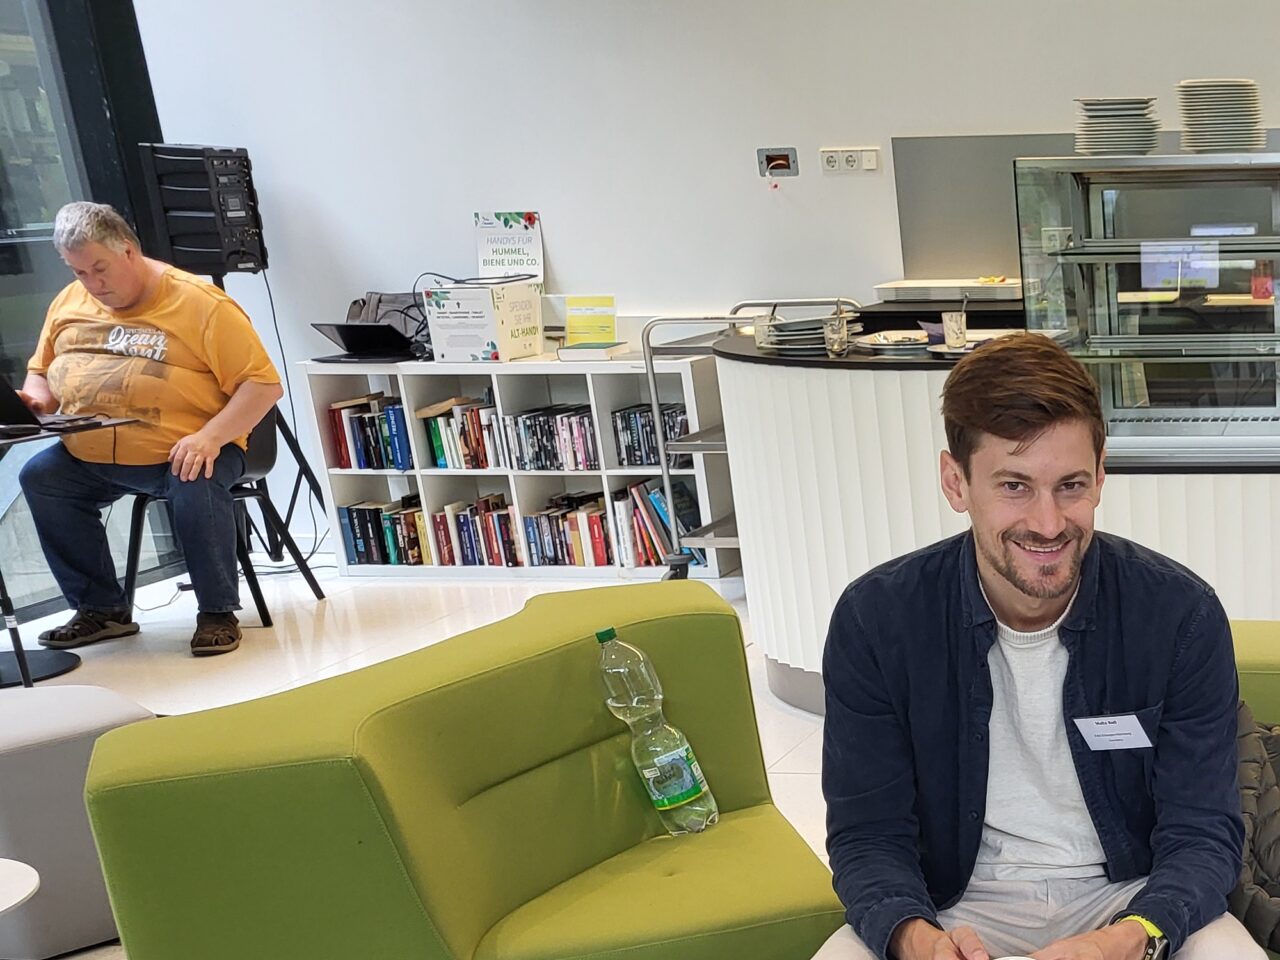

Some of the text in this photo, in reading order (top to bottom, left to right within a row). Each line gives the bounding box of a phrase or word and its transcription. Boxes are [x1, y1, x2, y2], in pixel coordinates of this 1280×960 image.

[491, 247, 529, 257] HUMMEL,
[482, 258, 506, 266] BIENE
[507, 258, 525, 266] UND
[109, 325, 167, 345] Ocean
